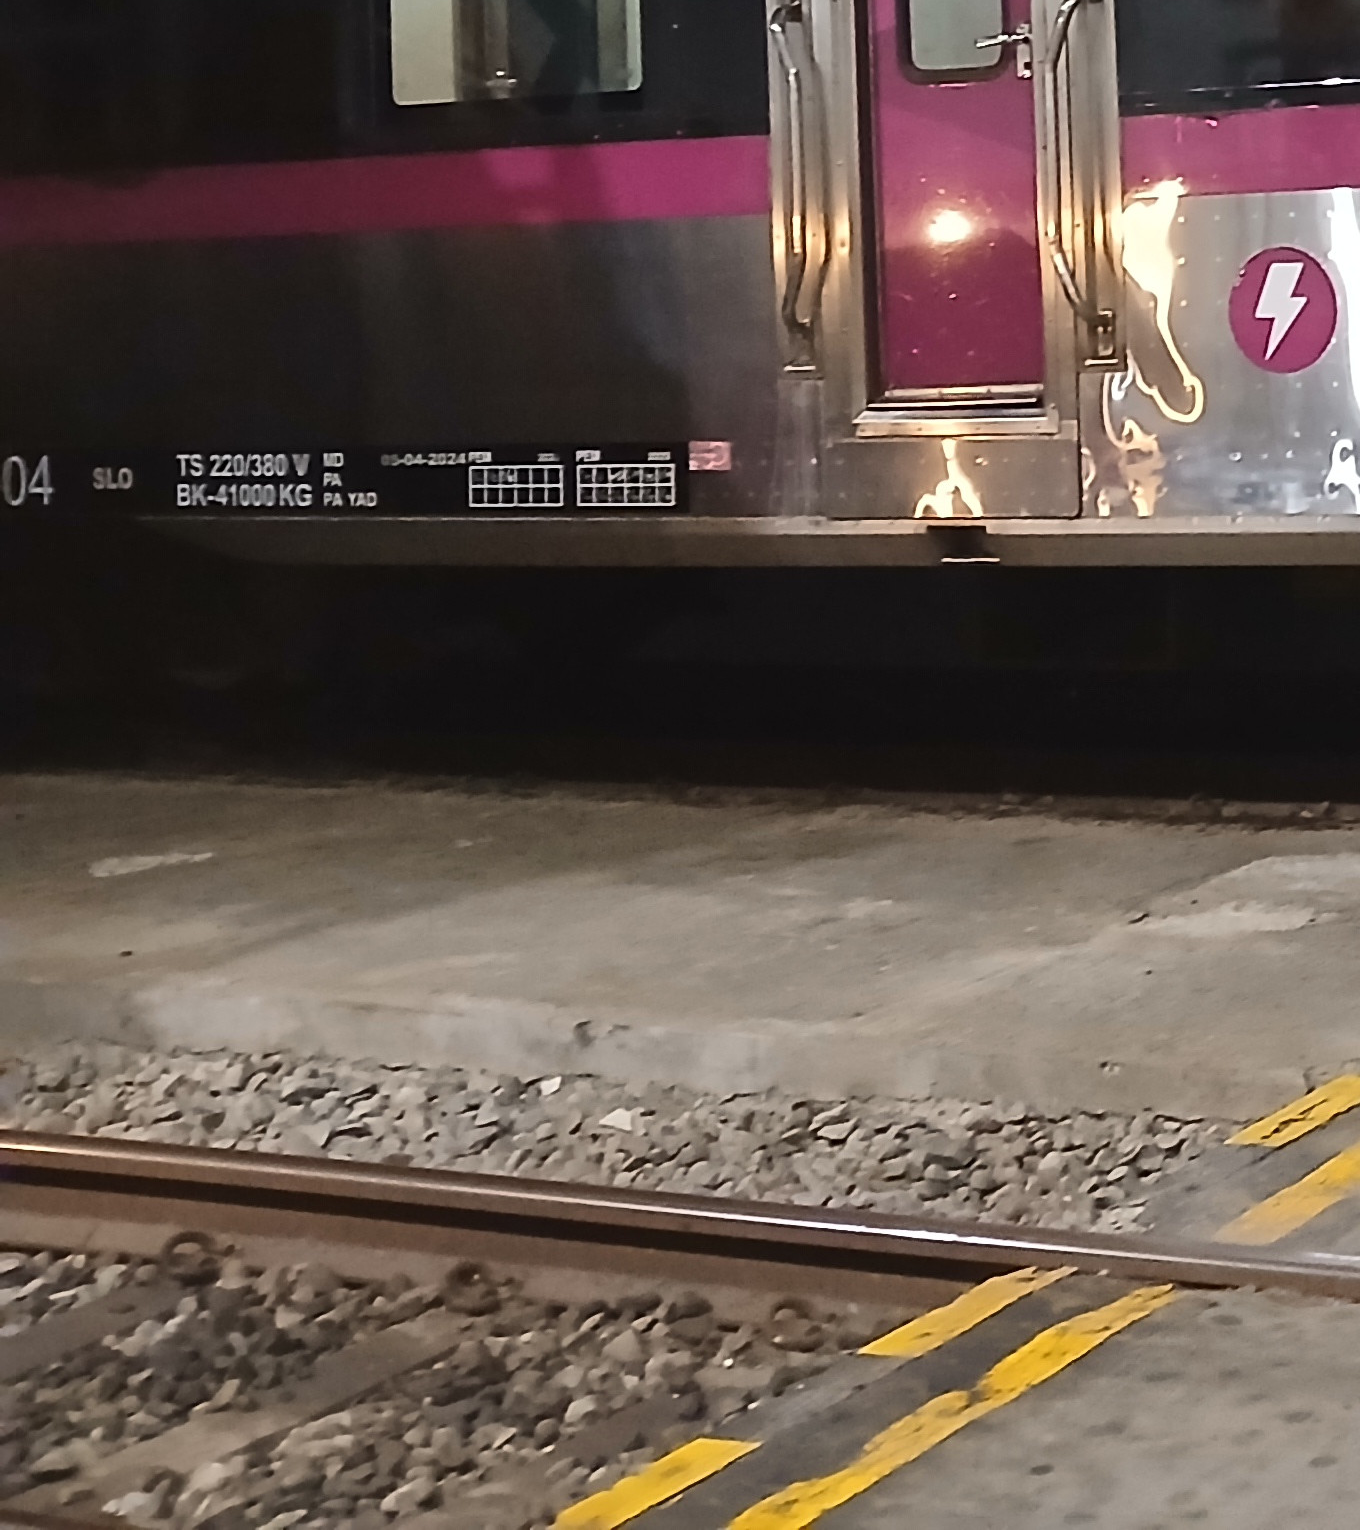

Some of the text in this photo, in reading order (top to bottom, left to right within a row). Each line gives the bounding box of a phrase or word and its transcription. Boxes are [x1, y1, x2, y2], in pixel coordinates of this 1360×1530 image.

[176, 453, 310, 477] TS 220/380 V
[2, 455, 55, 506] 04
[92, 467, 133, 490] SLO
[279, 483, 313, 507] KG
[348, 491, 378, 507] YAD
